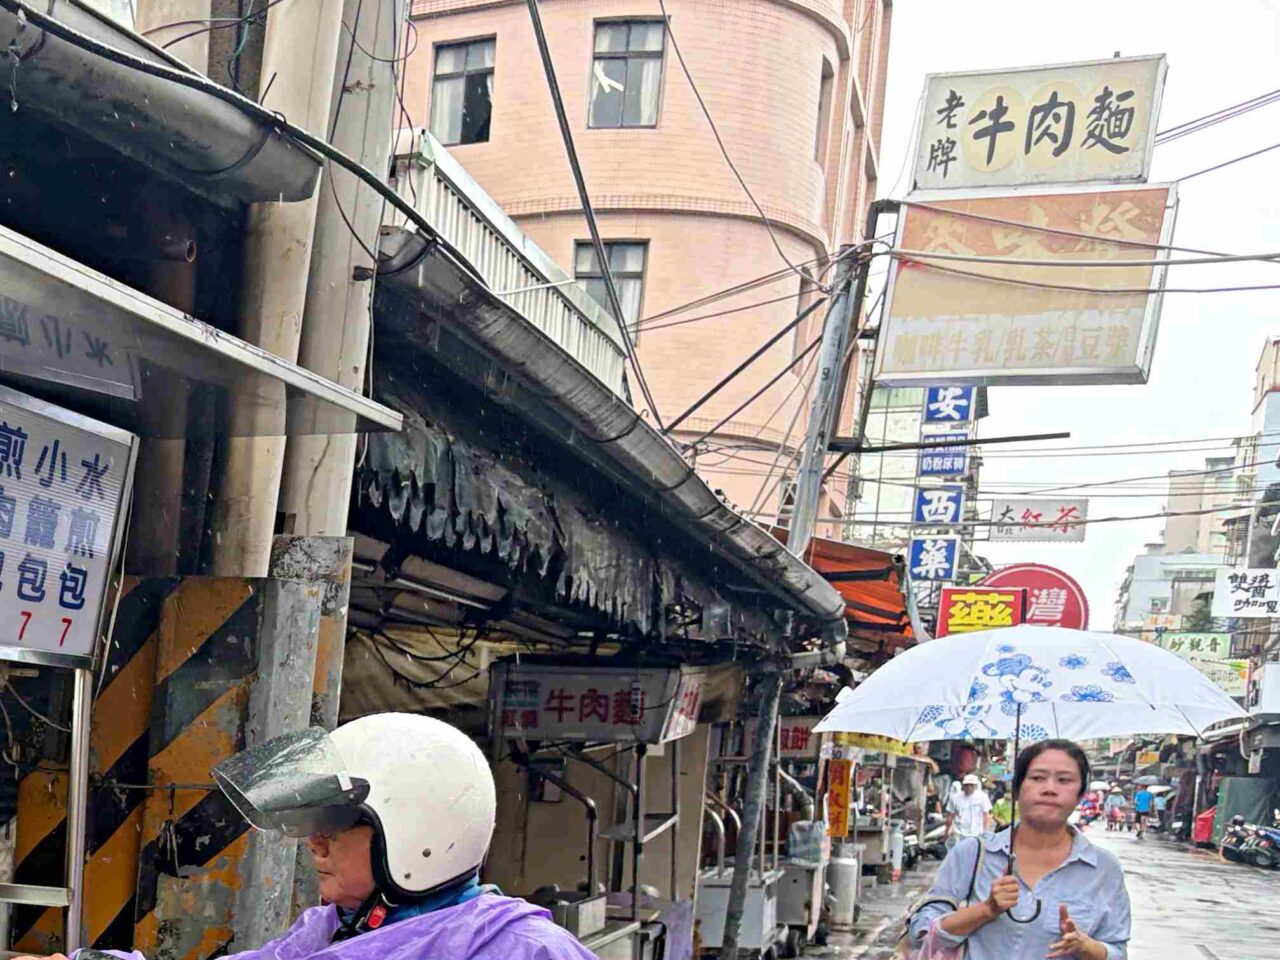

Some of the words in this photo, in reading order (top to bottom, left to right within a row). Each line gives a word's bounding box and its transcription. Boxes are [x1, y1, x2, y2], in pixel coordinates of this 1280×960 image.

[925, 90, 965, 178] 老牌
[968, 86, 1136, 167] 牛肉麵
[929, 386, 968, 420] 安
[16, 439, 66, 604] 小籠包
[60, 454, 109, 611] 水煎包
[19, 611, 31, 638] 7
[59, 617, 73, 645] 7
[948, 592, 1015, 633] 藥
